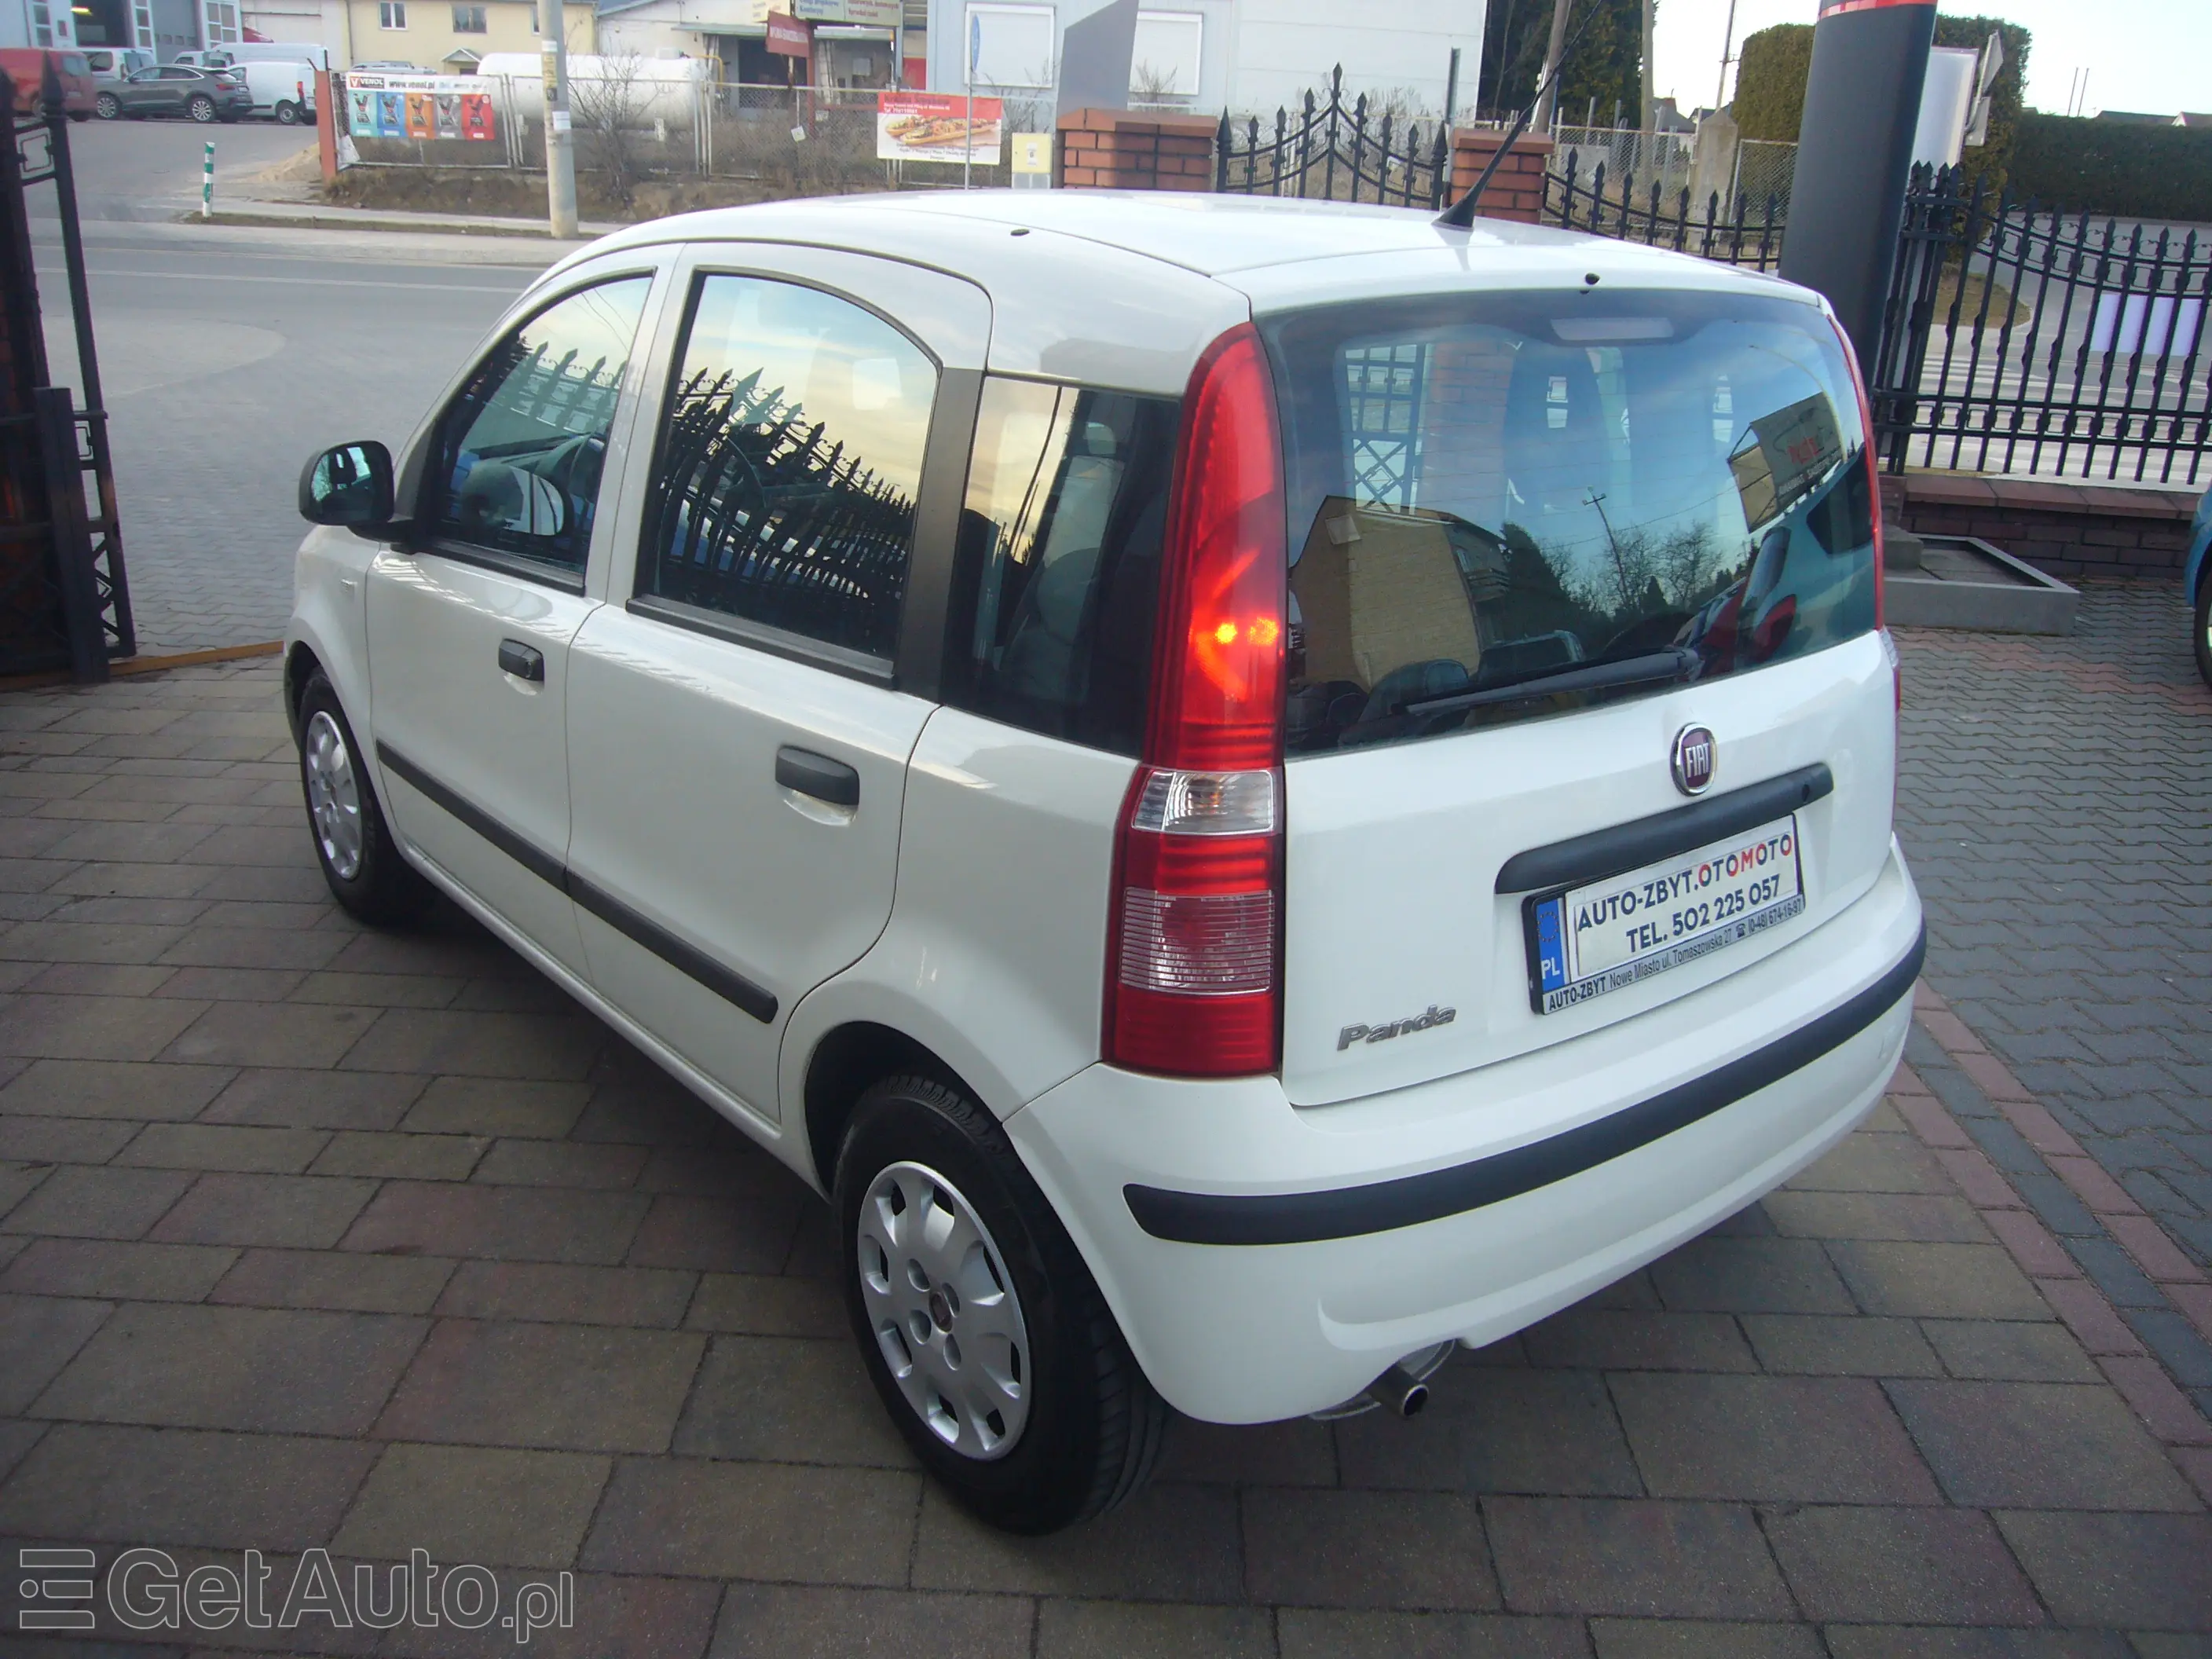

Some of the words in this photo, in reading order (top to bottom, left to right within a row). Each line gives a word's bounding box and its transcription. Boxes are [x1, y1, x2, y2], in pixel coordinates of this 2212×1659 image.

[1685, 742, 1709, 778] FIAT
[1626, 922, 1668, 953] TEL.
[1672, 903, 1710, 936] 502
[1714, 888, 1745, 921] 225
[1749, 873, 1781, 905] 057
[1541, 957, 1560, 980] PL
[1549, 976, 1606, 1011] AUTO-ZBYT
[1610, 971, 1633, 989] Nowe
[1634, 960, 1661, 983] Miasto
[1661, 954, 1672, 969] ul.
[1672, 934, 1723, 963] Tomaszowska
[1723, 928, 1732, 943] 27
[1337, 1004, 1457, 1051] Panda
